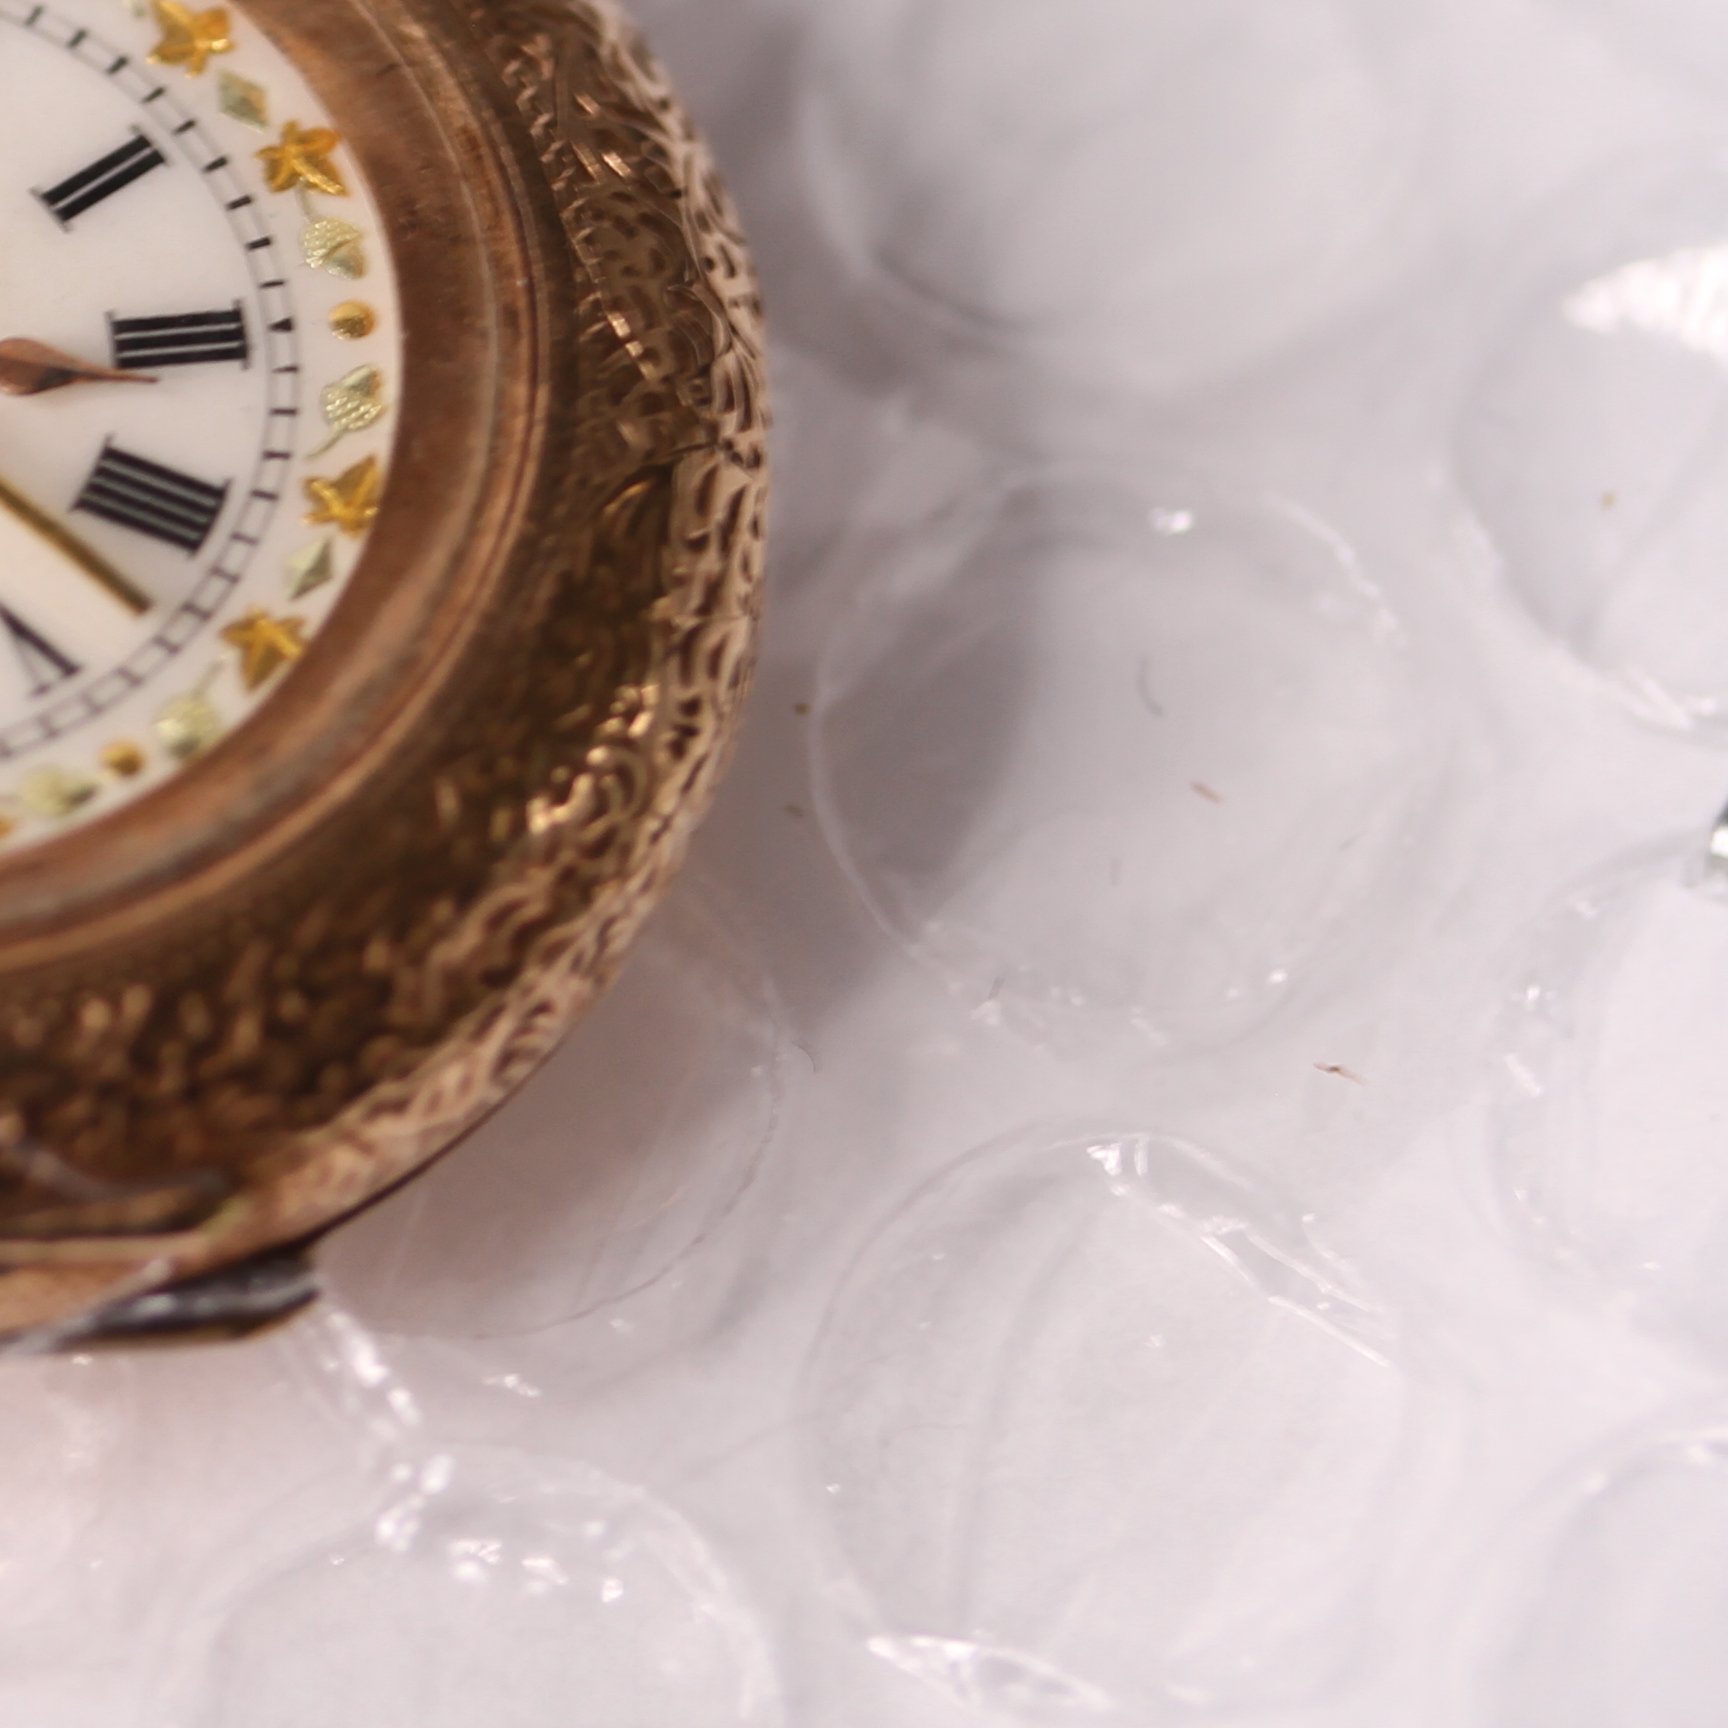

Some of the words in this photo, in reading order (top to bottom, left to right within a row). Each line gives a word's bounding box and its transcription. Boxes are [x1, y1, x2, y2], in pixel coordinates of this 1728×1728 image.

[35, 129, 165, 229] II
[110, 303, 246, 368] III
[72, 437, 229, 555] IIII
